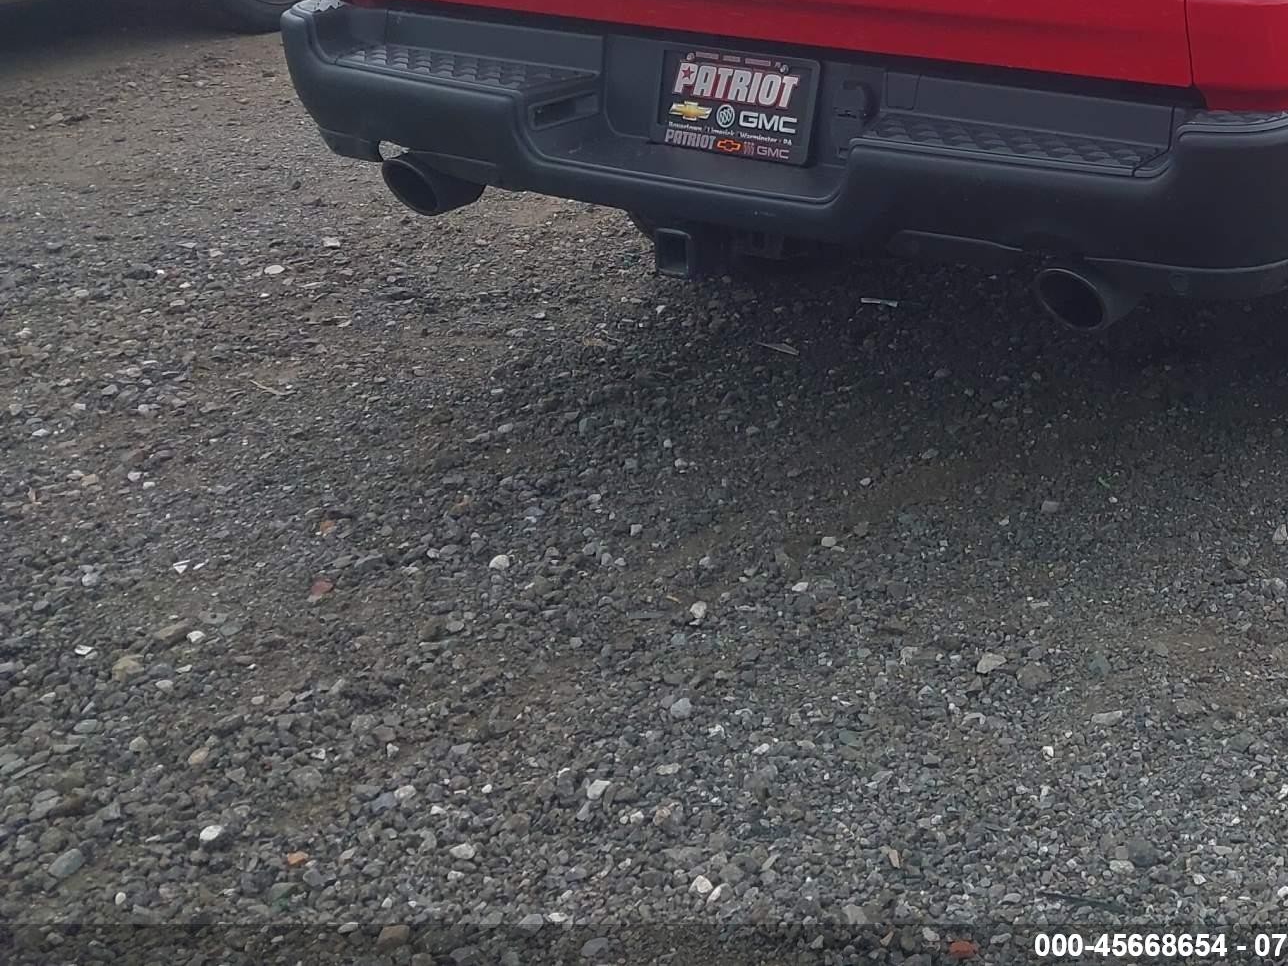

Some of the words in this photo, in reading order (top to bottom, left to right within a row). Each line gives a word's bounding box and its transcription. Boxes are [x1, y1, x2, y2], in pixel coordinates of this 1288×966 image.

[673, 62, 799, 110] PATRIOT
[739, 110, 798, 134] GMC
[664, 129, 717, 150] PATRIOT
[757, 145, 790, 160] GMC
